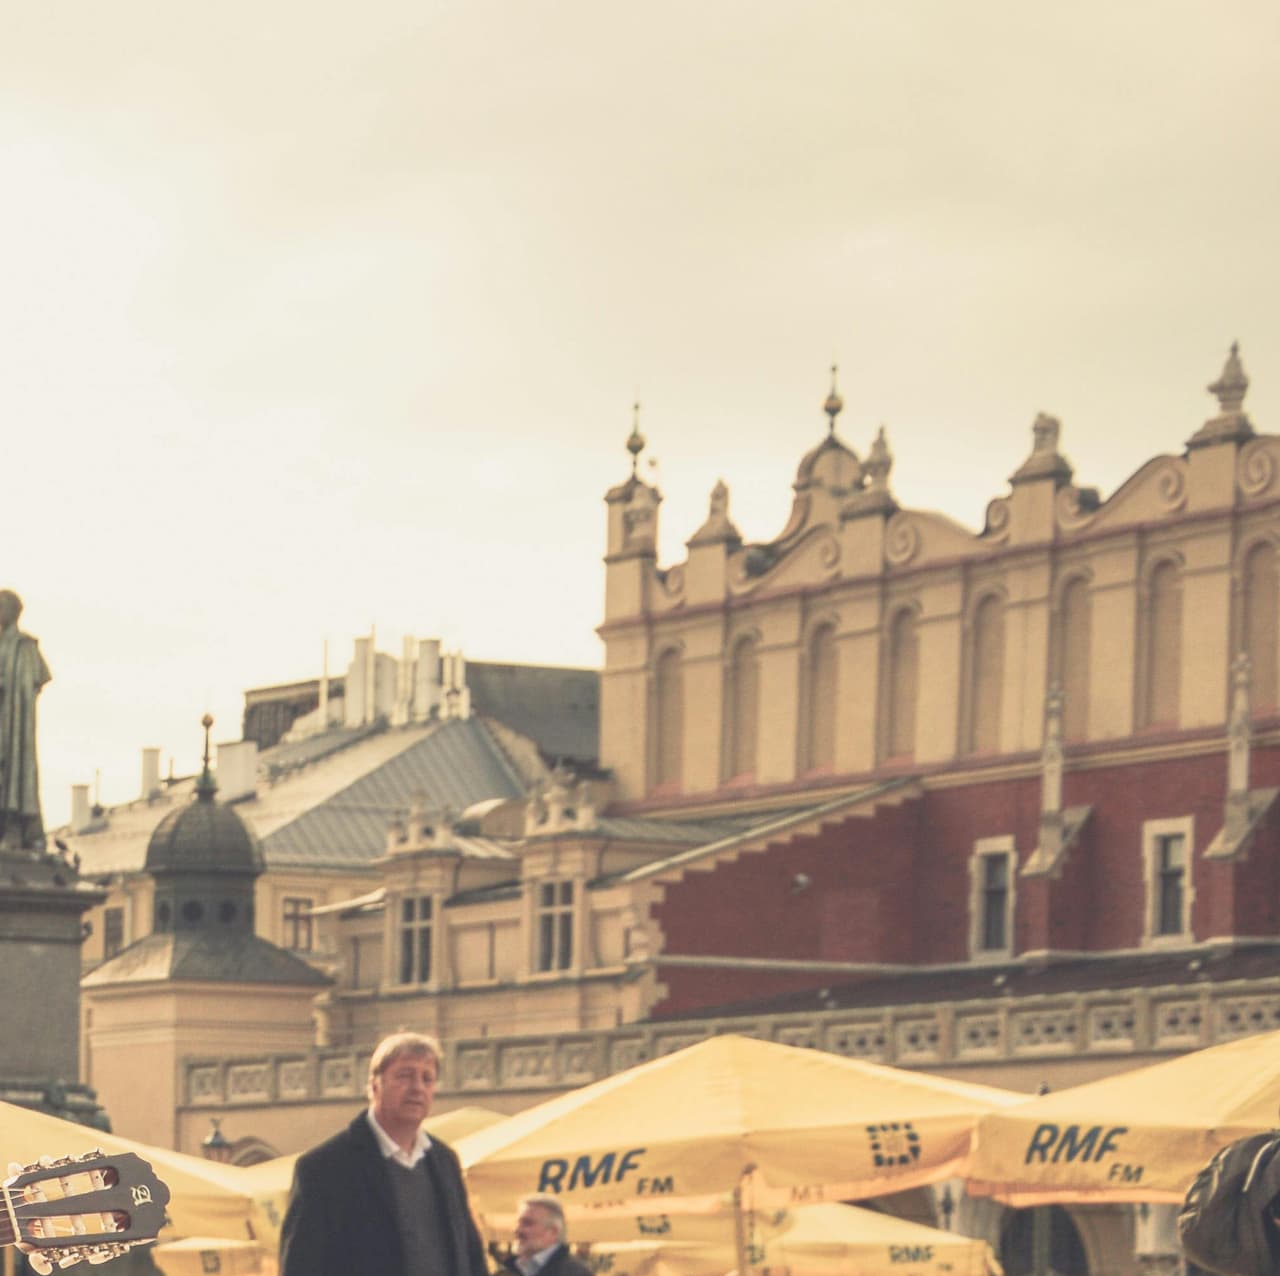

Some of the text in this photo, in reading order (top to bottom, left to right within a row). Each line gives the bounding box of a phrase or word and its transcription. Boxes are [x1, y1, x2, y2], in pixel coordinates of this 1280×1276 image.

[538, 1148, 673, 1195] RMF FM
[1023, 1123, 1144, 1182] RMF FM
